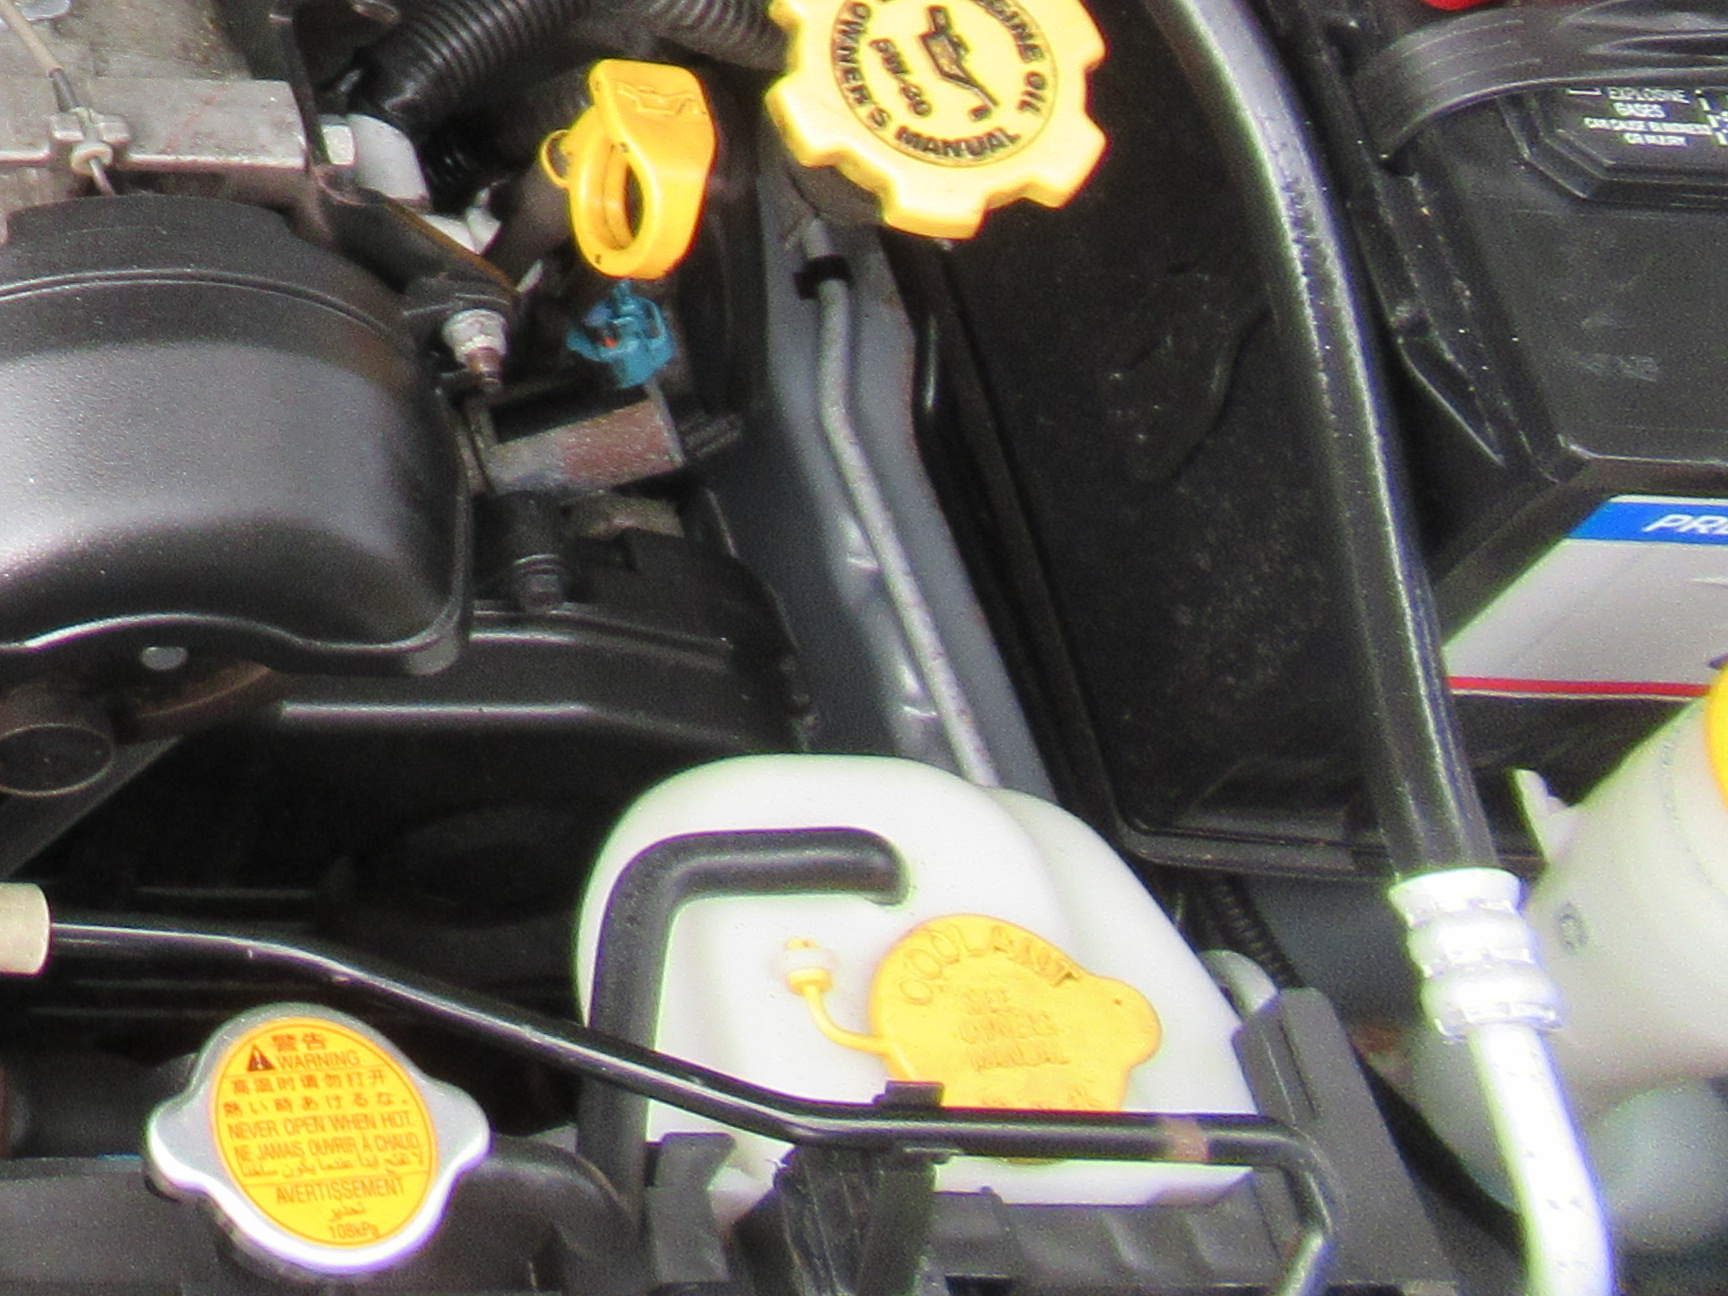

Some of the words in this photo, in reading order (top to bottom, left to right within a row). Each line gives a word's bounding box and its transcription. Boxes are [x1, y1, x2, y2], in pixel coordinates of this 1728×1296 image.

[1016, 70, 1049, 117] OIL
[894, 125, 1022, 160] MANUAL
[898, 923, 1084, 1005] COOLANT
[271, 1032, 327, 1052] 警告
[278, 1050, 360, 1070] WARNING
[231, 1069, 386, 1095] 高温时请勿打开
[227, 1120, 279, 1140] NEVER
[283, 1116, 325, 1136] OPEN
[328, 1114, 376, 1132] WHEN
[234, 1145, 252, 1163] NE
[257, 1141, 305, 1161] JAMAIS
[308, 1137, 356, 1157] OUVRIR
[275, 1177, 406, 1205] AVERTISSEMENT
